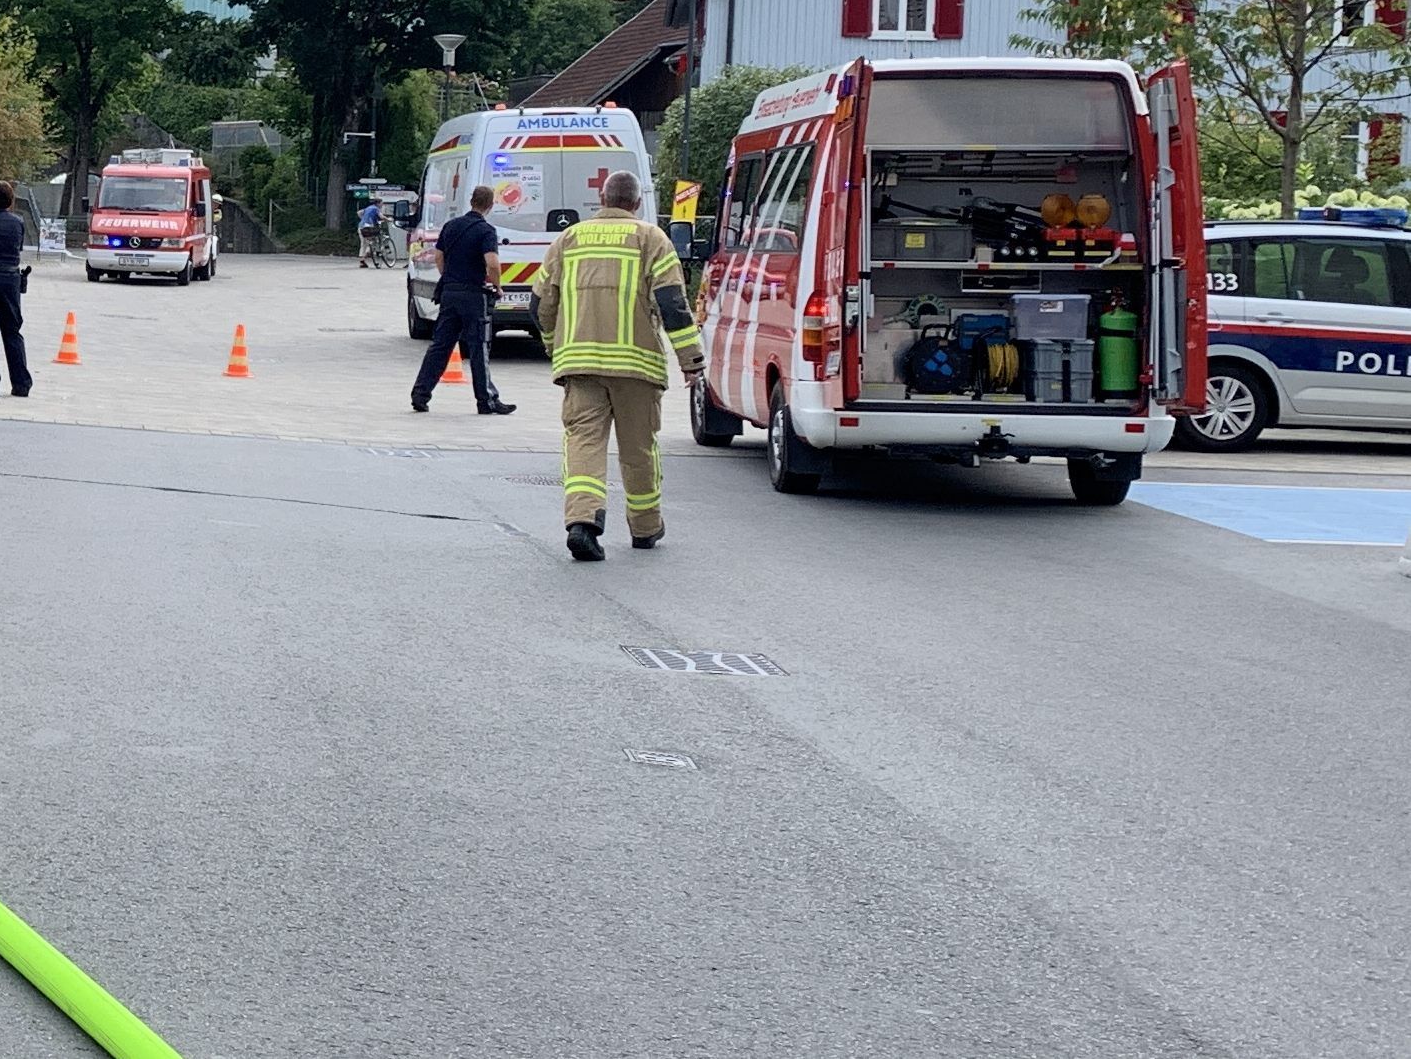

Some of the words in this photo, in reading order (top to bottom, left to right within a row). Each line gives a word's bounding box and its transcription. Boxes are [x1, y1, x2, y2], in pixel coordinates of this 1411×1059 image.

[517, 117, 609, 130] AMBULANCE
[97, 218, 179, 231] FEUERWEHR
[569, 223, 638, 237] FEUERWEHR
[576, 233, 628, 246] WOLFURT
[1206, 273, 1239, 291] 133
